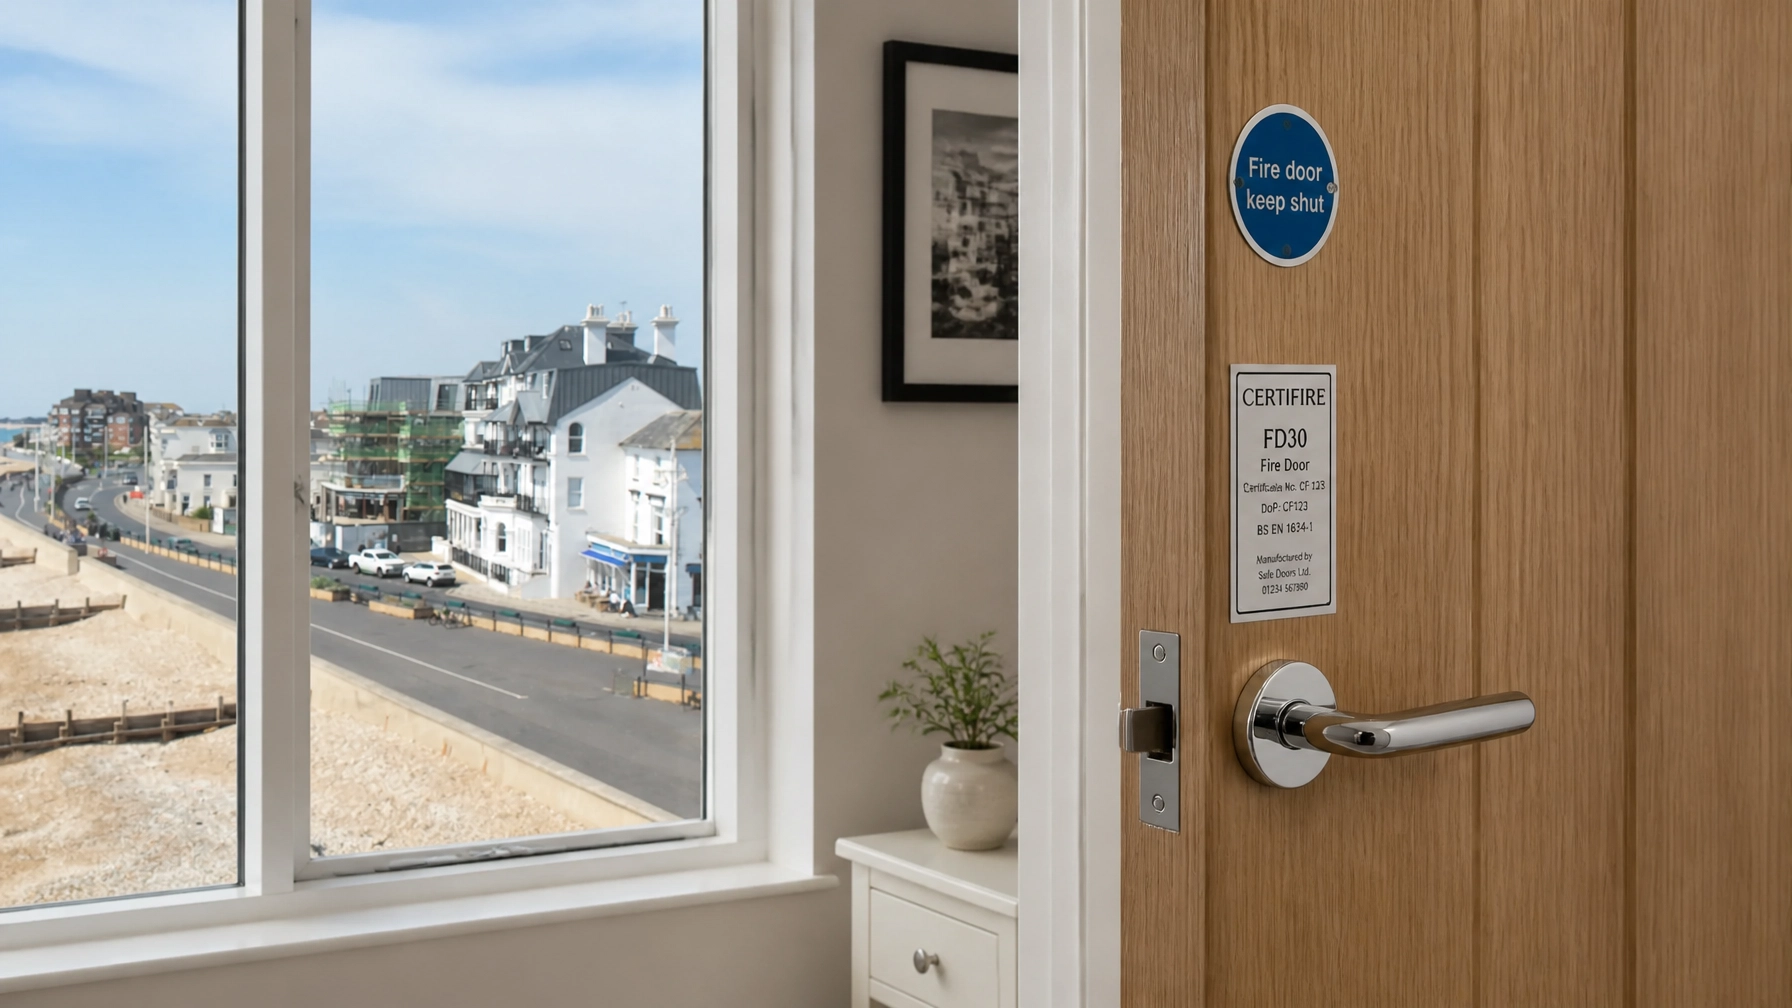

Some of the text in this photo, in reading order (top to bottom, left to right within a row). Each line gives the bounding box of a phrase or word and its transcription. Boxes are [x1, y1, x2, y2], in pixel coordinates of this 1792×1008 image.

[1248, 156, 1323, 182] Fire door
[1246, 188, 1325, 215] keep shut
[1242, 387, 1326, 407] CERTIFIRE
[1263, 427, 1308, 449] FD30
[1260, 458, 1310, 472] Fire Door
[1299, 480, 1310, 491] CF
[1311, 480, 1326, 490] 123
[1261, 501, 1308, 514] DoP: CF123
[1257, 524, 1269, 536] BS
[1271, 523, 1284, 535] EN
[1256, 551, 1313, 565] Manufactured by
[1275, 568, 1296, 579] Doors
[1261, 584, 1283, 595] 01234
